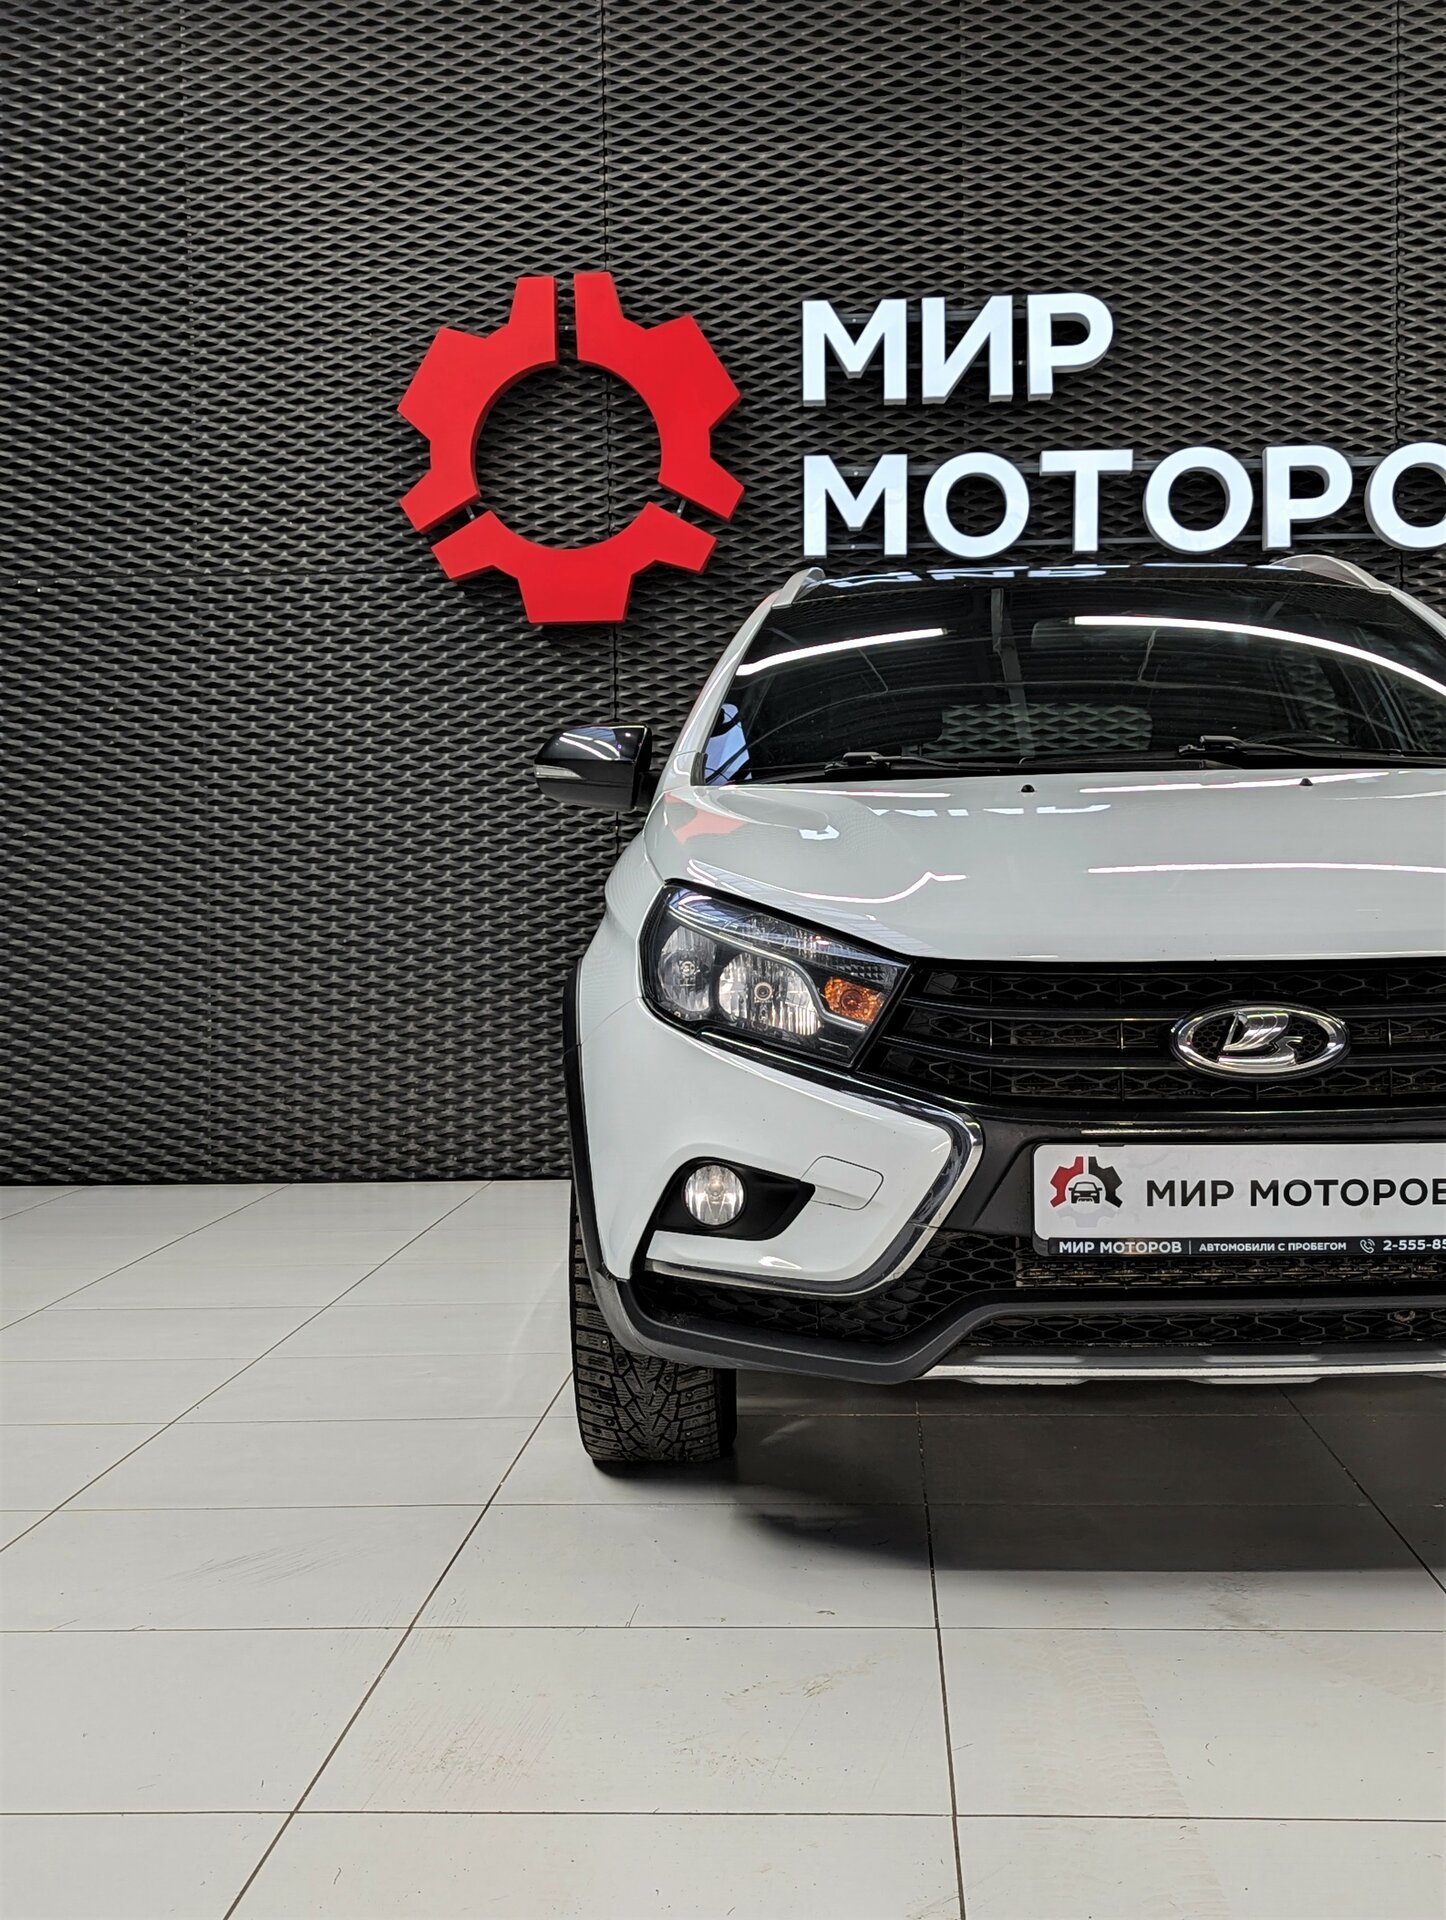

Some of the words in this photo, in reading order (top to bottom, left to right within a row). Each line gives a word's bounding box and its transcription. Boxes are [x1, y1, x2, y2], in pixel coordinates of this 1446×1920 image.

[801, 292, 1113, 405] МИР
[802, 441, 1446, 558] МОТОРО
[1146, 1180, 1234, 1207] МИР
[1059, 1242, 1095, 1253] МИР
[1100, 1241, 1182, 1253] МОТОРОВ
[1199, 1243, 1275, 1252] АВТОМОБИЛИ
[1278, 1243, 1285, 1251] С
[1288, 1242, 1347, 1251] ПРОБЕГОМ
